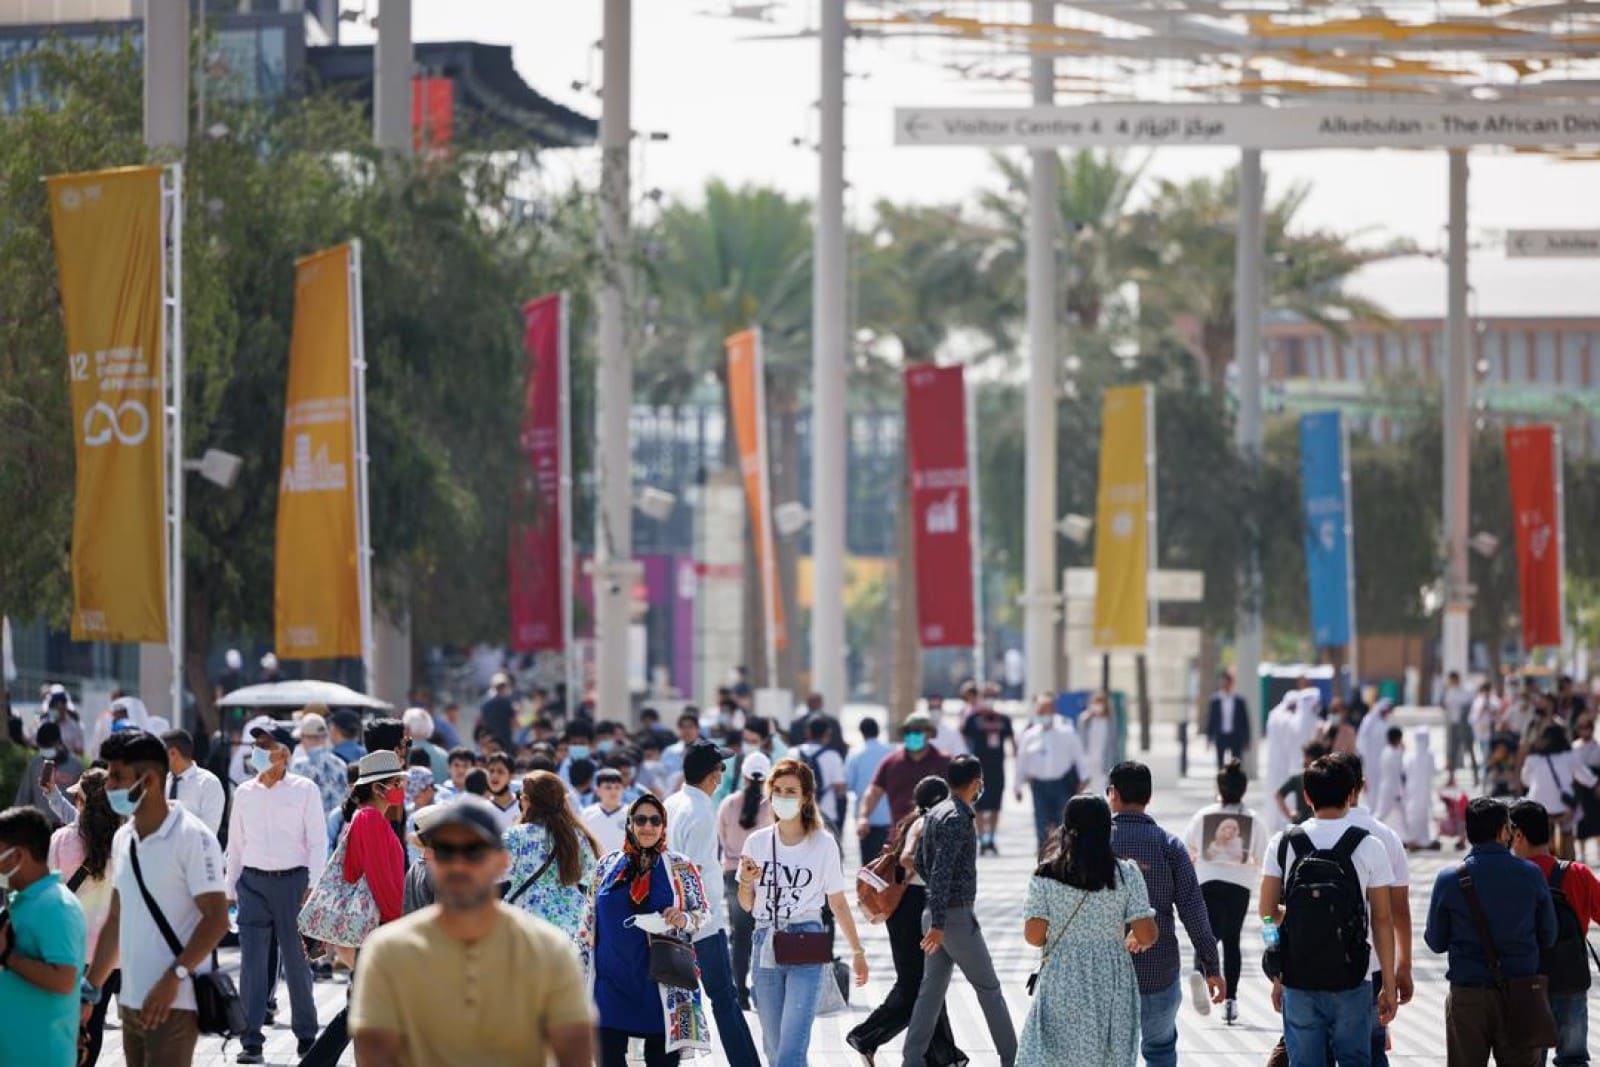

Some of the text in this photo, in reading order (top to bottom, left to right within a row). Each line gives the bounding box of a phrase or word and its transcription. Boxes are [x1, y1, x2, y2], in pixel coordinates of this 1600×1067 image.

[944, 117, 1008, 136] Visitor
[1015, 117, 1083, 136] Centre
[1319, 113, 1422, 134] Alkebulan
[1442, 113, 1479, 134] The
[1484, 113, 1559, 134] African
[70, 352, 89, 381] 12
